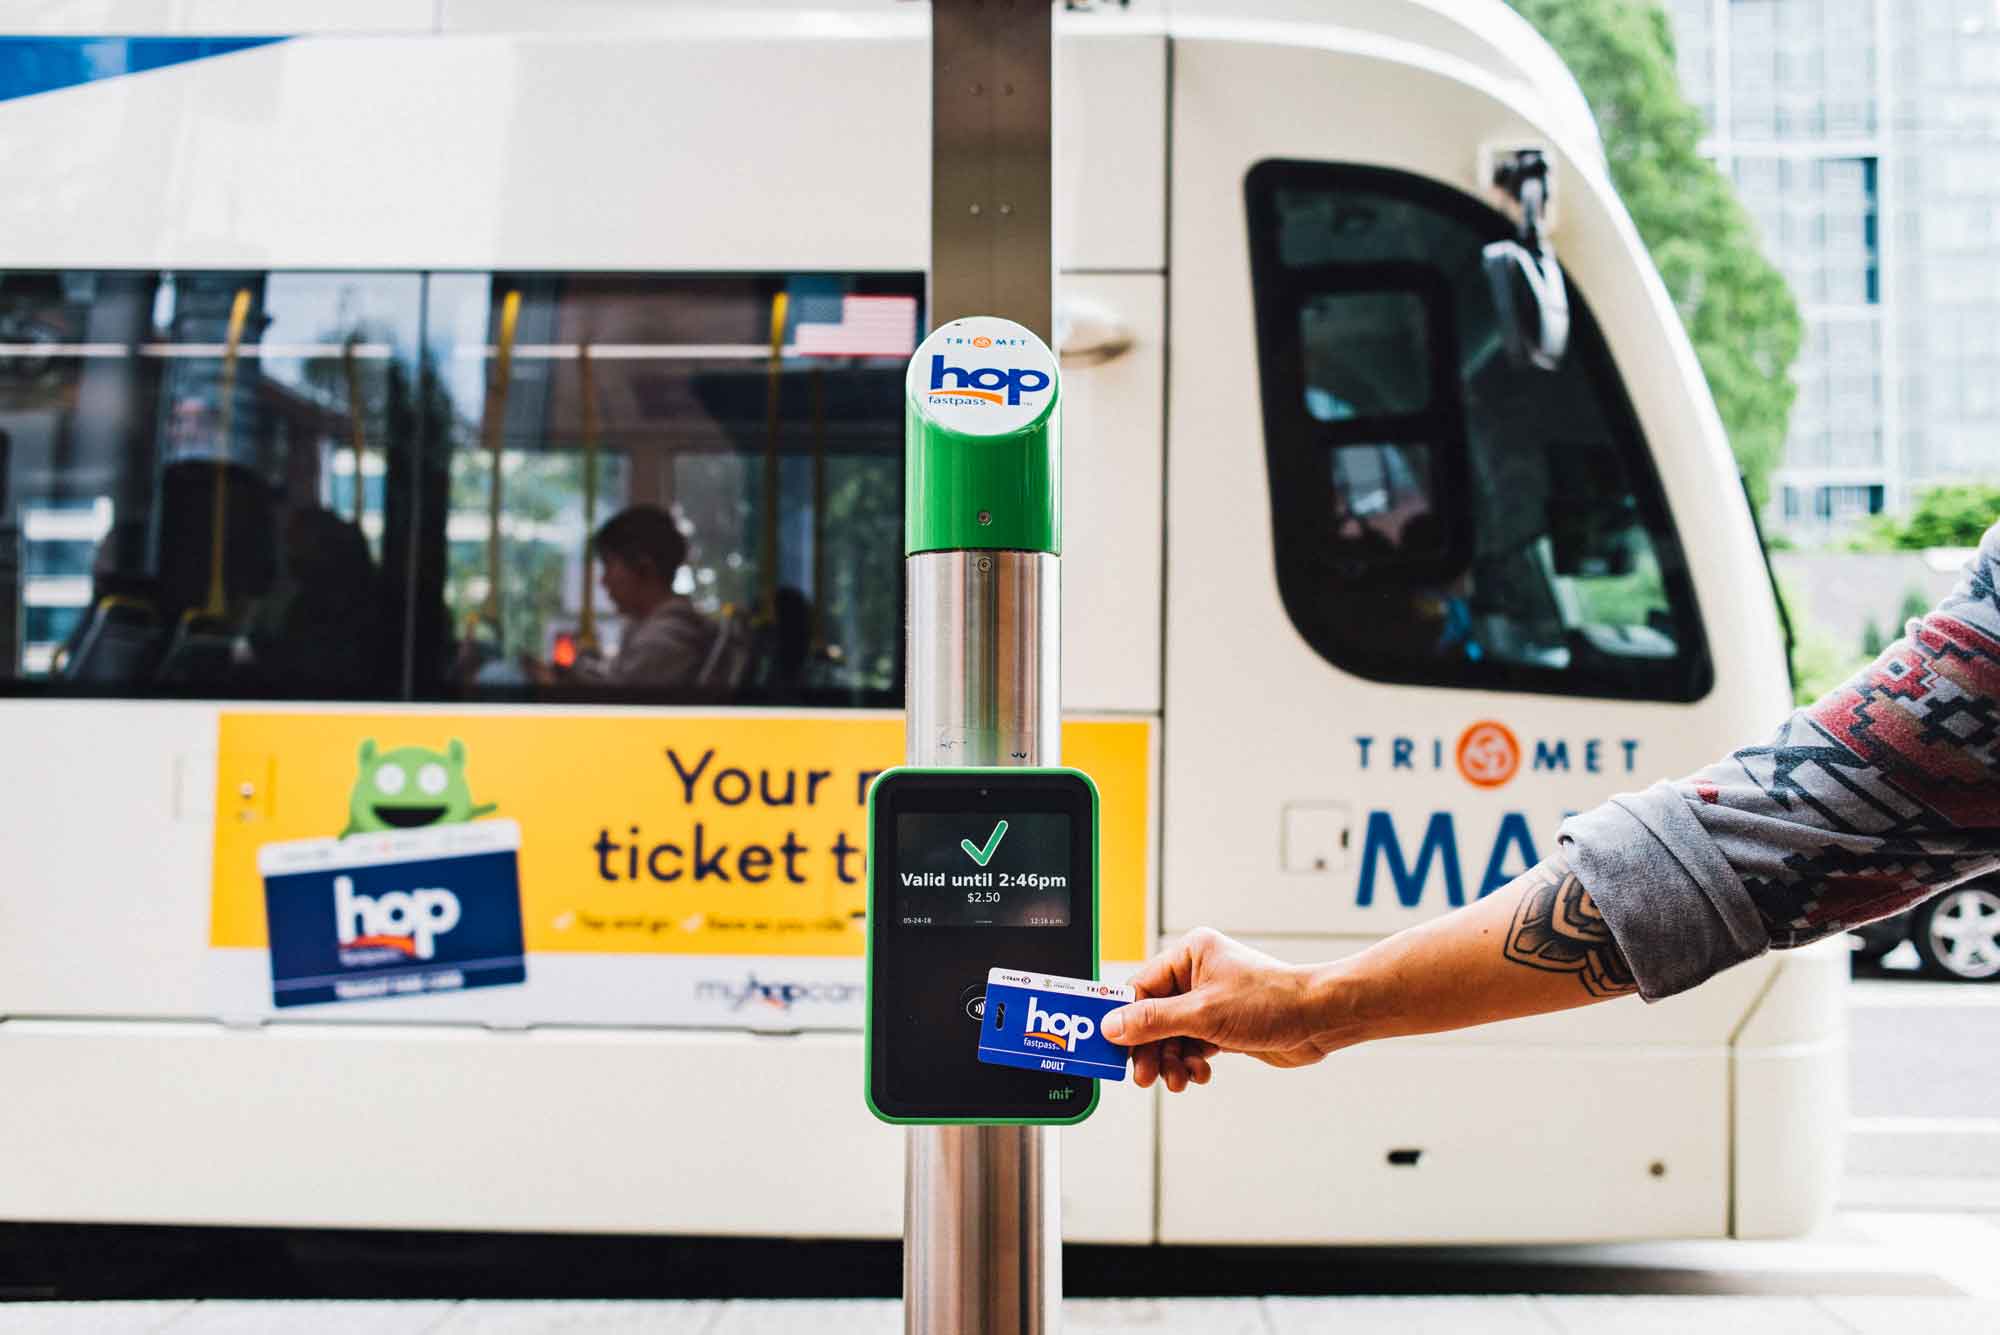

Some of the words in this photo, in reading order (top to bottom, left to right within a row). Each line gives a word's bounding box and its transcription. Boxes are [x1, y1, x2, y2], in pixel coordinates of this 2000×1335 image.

[928, 396, 986, 407] fastpass
[930, 354, 1050, 406] hop
[665, 748, 832, 807] Your
[593, 822, 809, 885] ticket
[830, 831, 867, 885] t
[1354, 810, 1582, 908] MA
[900, 873, 946, 887] Valid
[951, 873, 993, 887] until
[999, 873, 1067, 890] 2:46pm
[967, 892, 1001, 904] $2.50
[333, 874, 462, 960] hop
[1024, 1037, 1057, 1051] fastpass
[1025, 996, 1095, 1053] hop
[1040, 1059, 1065, 1071] ADULT
